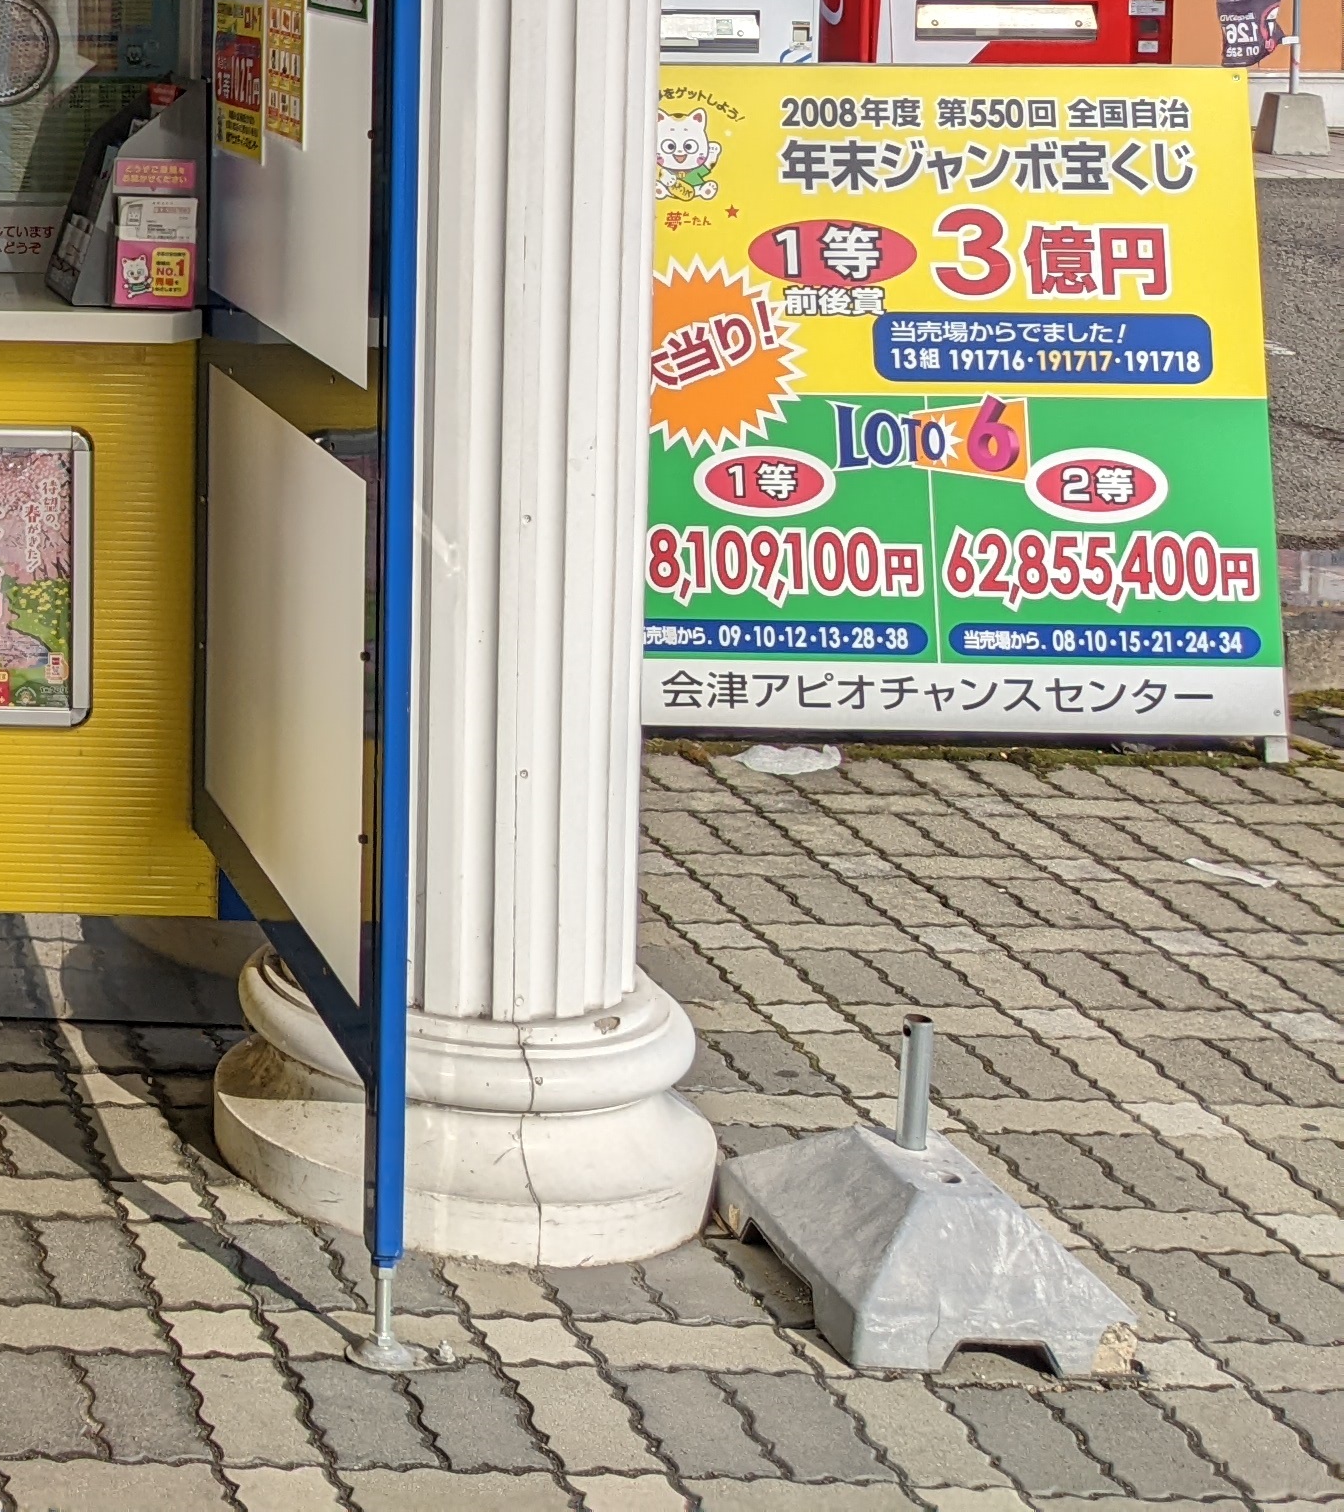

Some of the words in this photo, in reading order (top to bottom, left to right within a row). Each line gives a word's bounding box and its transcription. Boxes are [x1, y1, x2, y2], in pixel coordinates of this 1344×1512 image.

[659, 86, 746, 122] をゲットしよう!
[780, 96, 921, 129] 2008年度
[937, 96, 1058, 129] 第550回
[1068, 98, 1191, 131] 全国自治
[779, 139, 1196, 194] 年末ジャンボ宝くじ
[772, 227, 885, 282] 1等
[932, 203, 1171, 299] 3億円
[783, 286, 886, 317] 前後賞
[890, 320, 1127, 345] 当売場からでました!
[890, 348, 941, 371] 13組
[835, 402, 946, 470] LOTO
[965, 394, 1021, 472] 6
[725, 462, 799, 502] 1等
[1059, 465, 1135, 506] 2等
[945, 527, 1260, 609] 62,855,400円
[661, 669, 1215, 718] 会津アピオチャンスセンター
